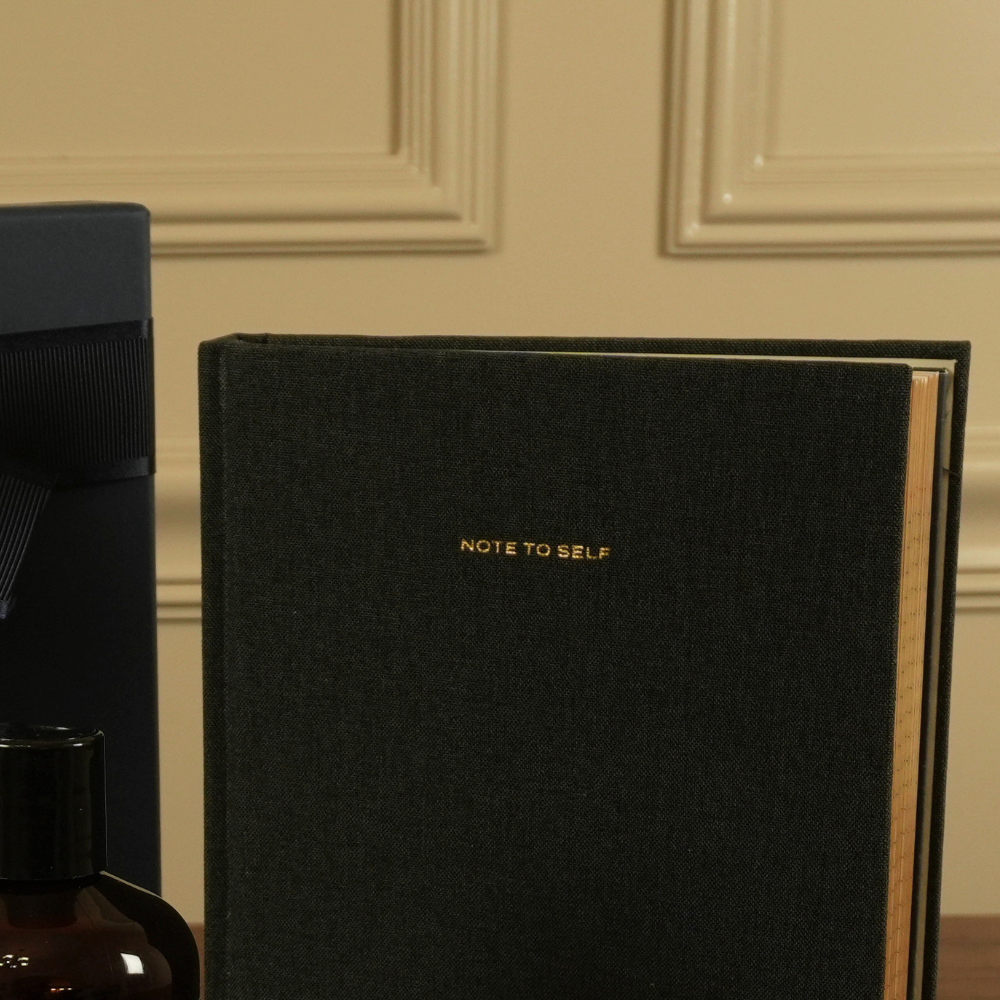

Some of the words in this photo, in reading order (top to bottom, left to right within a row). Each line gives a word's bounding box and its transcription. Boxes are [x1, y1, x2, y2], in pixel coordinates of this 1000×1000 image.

[460, 538, 517, 555] NOTE
[523, 542, 551, 557] TO
[557, 544, 612, 560] SELF
